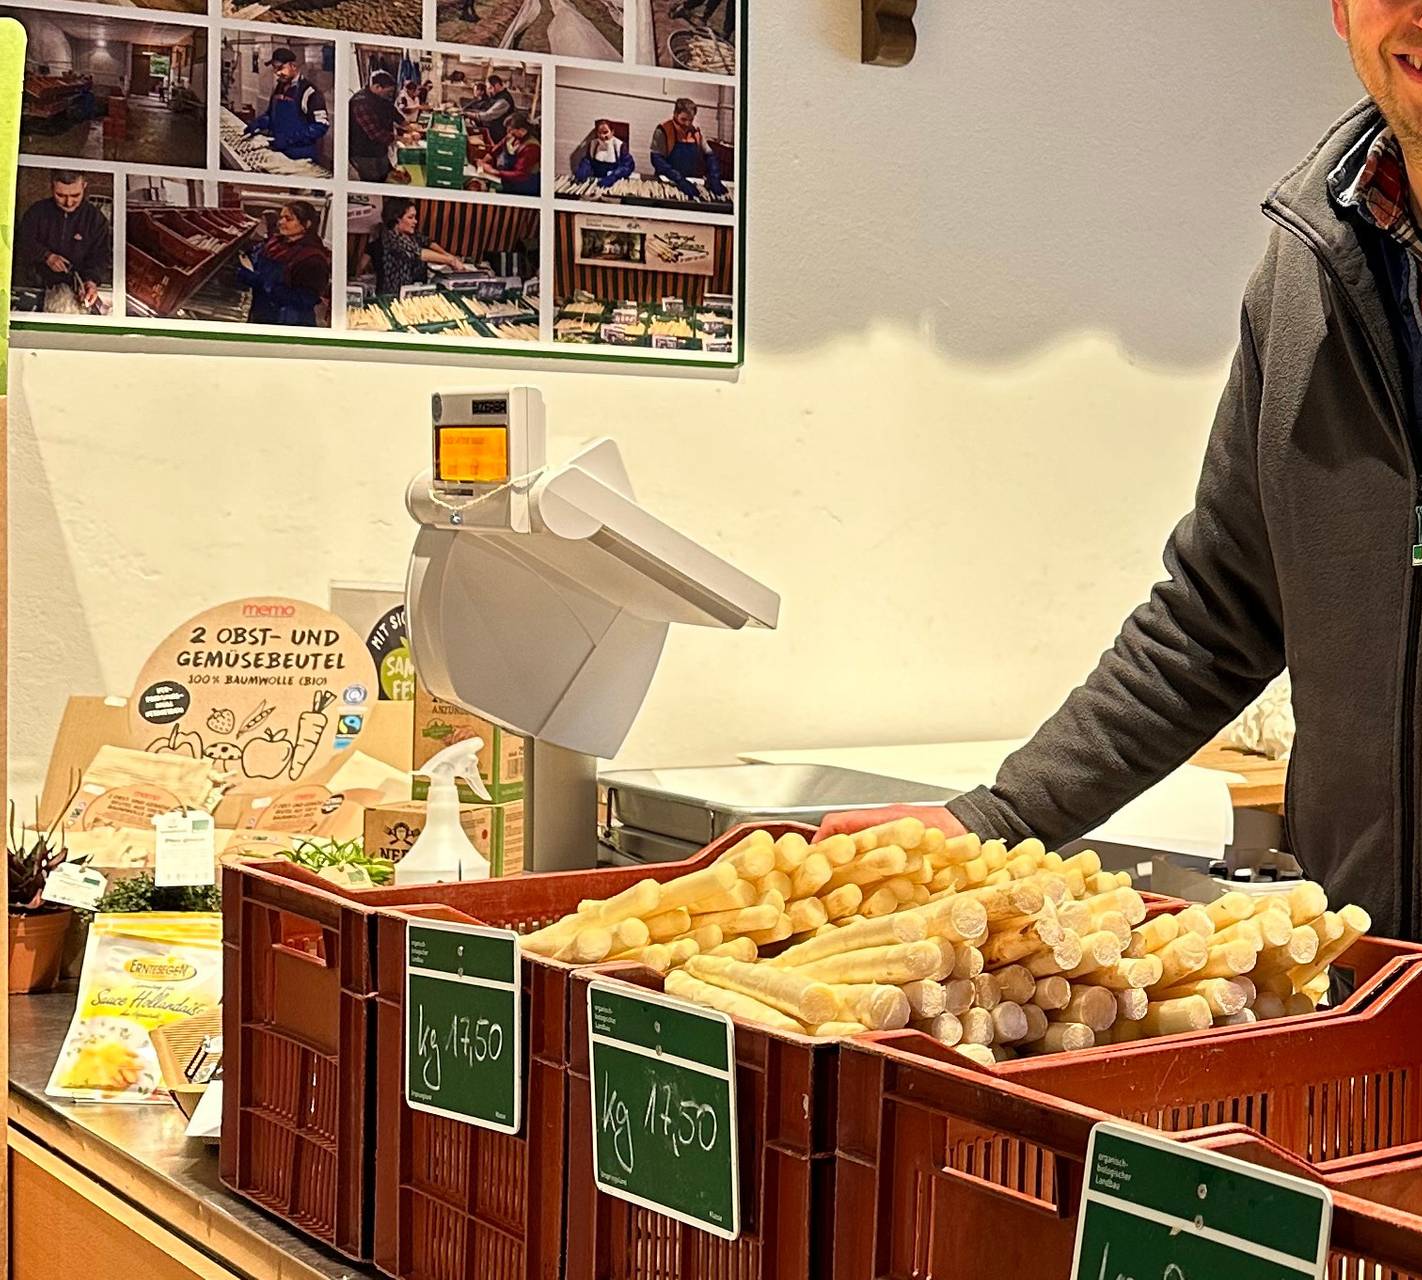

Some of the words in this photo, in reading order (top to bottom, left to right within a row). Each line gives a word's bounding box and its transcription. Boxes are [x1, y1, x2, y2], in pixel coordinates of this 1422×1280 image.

[242, 603, 295, 616] memo
[189, 627, 207, 644] 2
[216, 627, 282, 646] OBST-
[291, 629, 340, 647] UND
[371, 622, 390, 650] MIT
[176, 649, 346, 670] GEMÜSEBEUTEL
[224, 675, 294, 686] BAUMWOLLE
[299, 676, 328, 686] (BIO)
[91, 988, 128, 1007] Sauce
[418, 1003, 441, 1091] kg
[445, 1014, 503, 1068] 17,50
[603, 1069, 634, 1174] kg
[644, 1081, 718, 1158] 17,50
